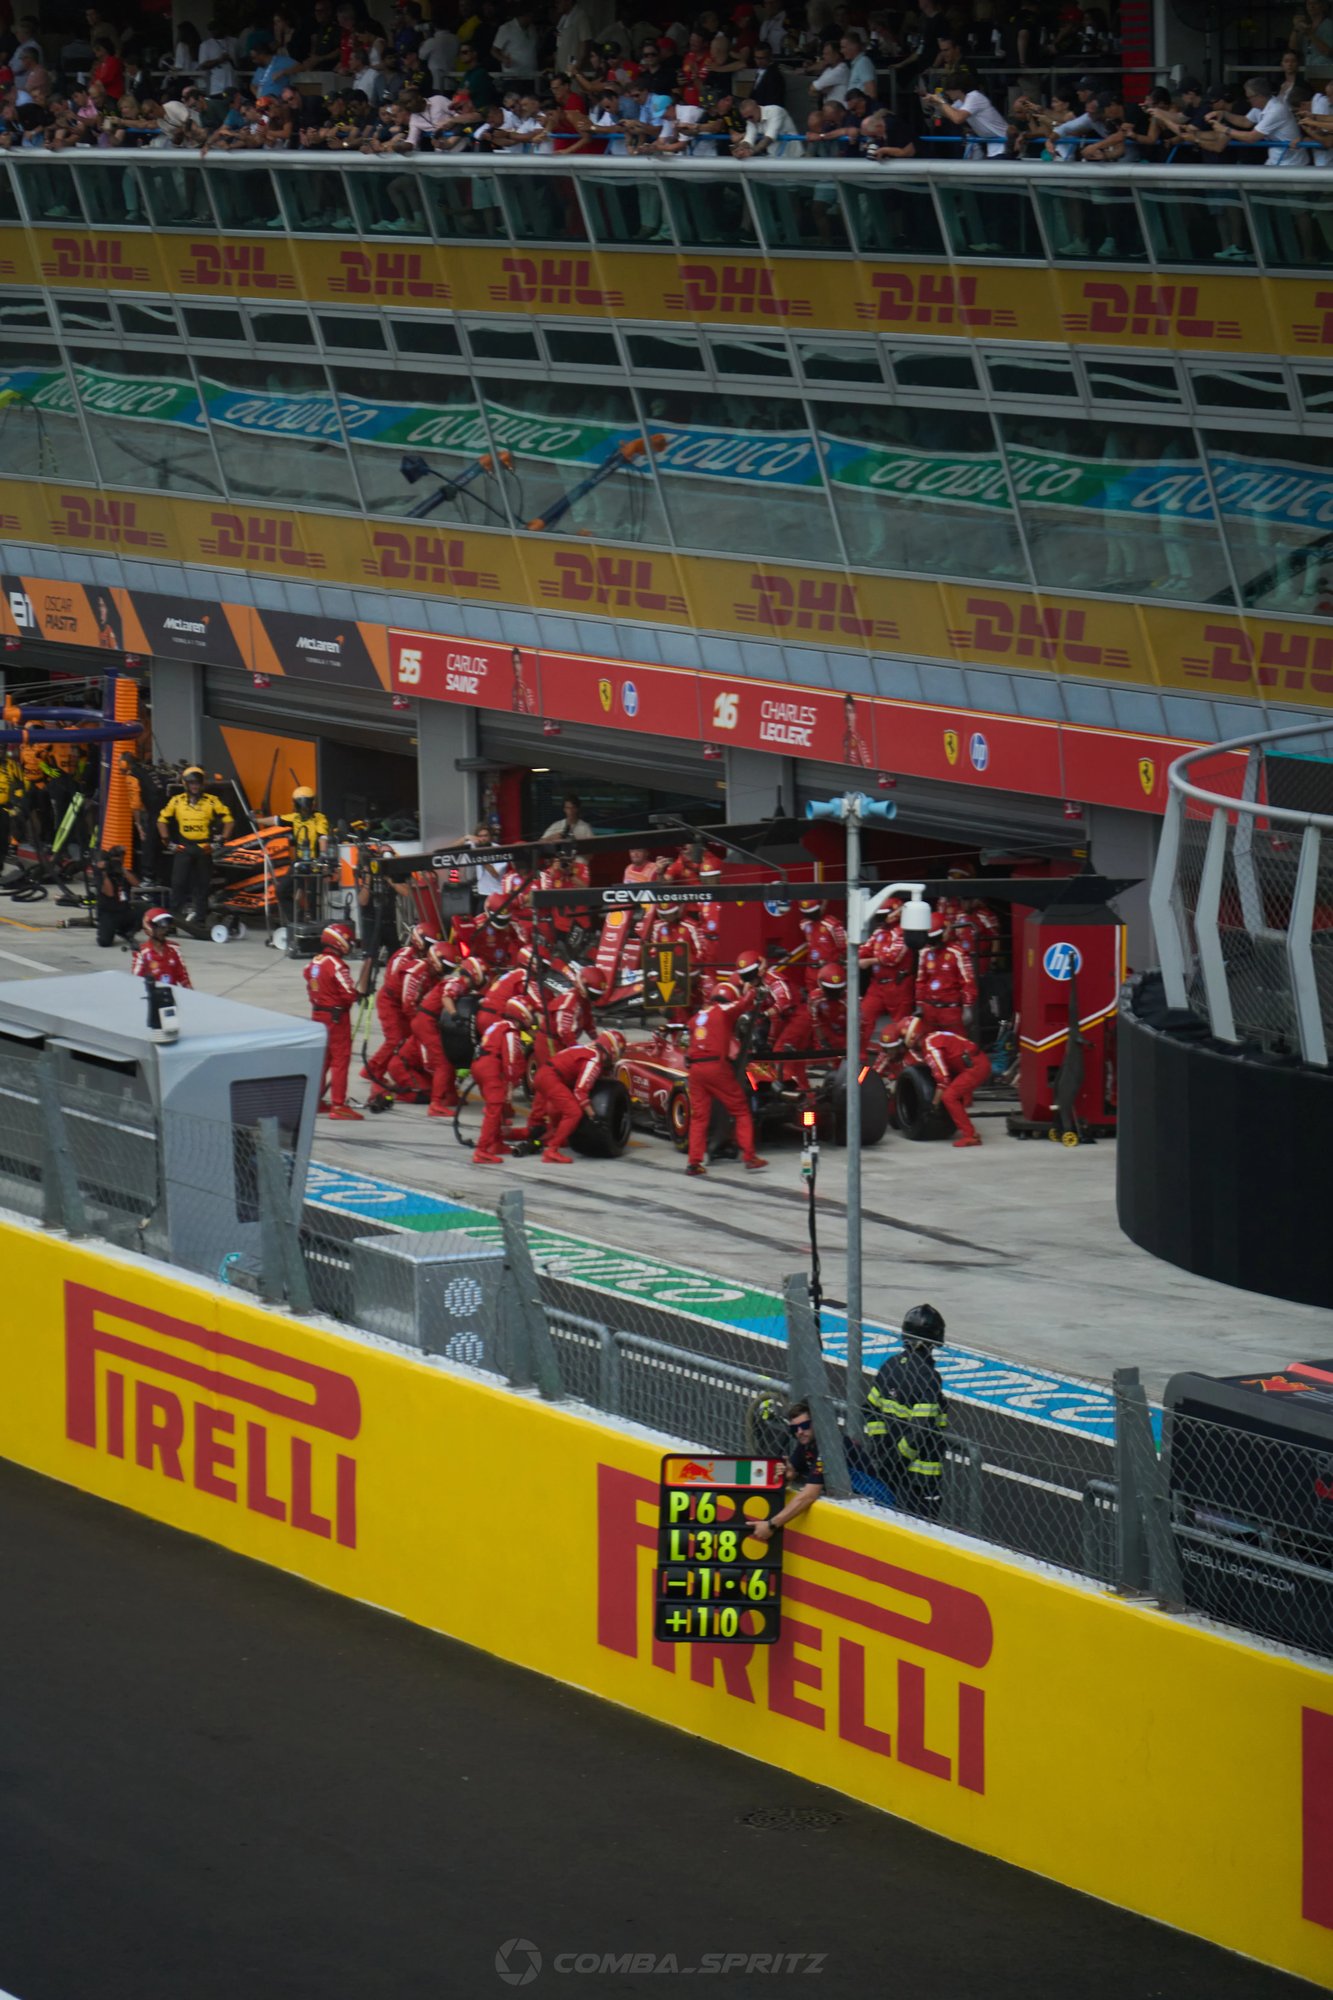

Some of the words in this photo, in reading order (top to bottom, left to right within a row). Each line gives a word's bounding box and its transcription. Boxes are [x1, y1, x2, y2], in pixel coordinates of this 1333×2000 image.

[52, 238, 133, 281] DHL
[190, 244, 279, 289] DHL
[339, 251, 435, 299] DHL
[502, 258, 606, 306] DHL
[678, 265, 790, 316] DHL
[872, 272, 994, 327] DHL
[1082, 281, 1214, 338] DHL
[60, 496, 150, 546] DHL
[211, 513, 308, 567] DHL
[373, 532, 481, 589] DHL
[554, 552, 673, 611] DHL
[9, 591, 35, 628] 81
[163, 617, 206, 634] McLaren
[749, 573, 874, 638] DHL
[296, 636, 340, 654] McLaren
[965, 598, 1102, 666] DHL
[398, 648, 422, 685] 55
[445, 673, 479, 695] SAINZ
[446, 653, 488, 676] CARLOS
[712, 692, 739, 729] 16
[761, 700, 817, 726] CHARLES
[760, 721, 813, 747] LECLERC
[657, 893, 712, 901] LOGISTICS
[64, 1279, 361, 1550] PIRELLI
[669, 1491, 716, 1524] P6
[670, 1529, 737, 1563] L38
[665, 1607, 738, 1638] +10
